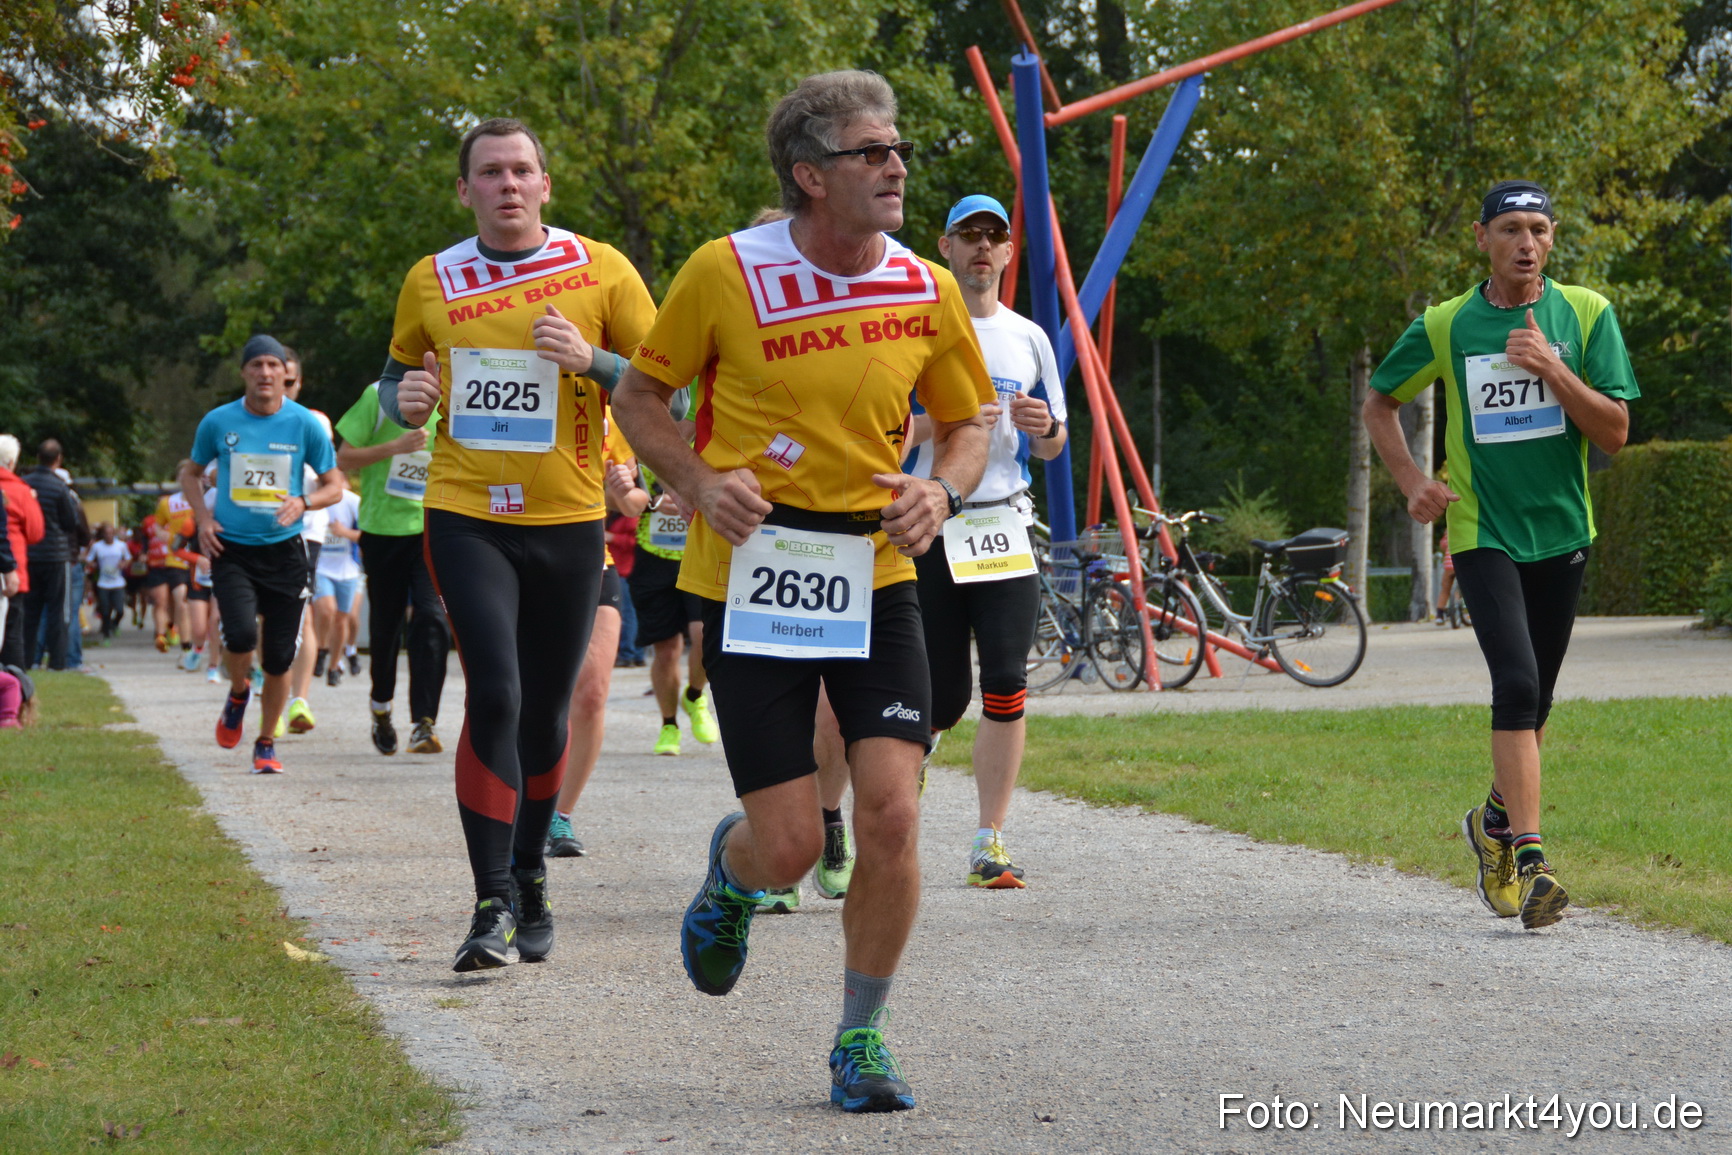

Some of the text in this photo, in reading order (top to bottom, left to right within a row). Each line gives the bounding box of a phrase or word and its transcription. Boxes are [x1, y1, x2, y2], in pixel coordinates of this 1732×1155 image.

[448, 272, 599, 326] MAX BÖGL
[762, 313, 939, 362] MAX BÖGL
[490, 358, 528, 368] BOCK
[466, 379, 540, 412] 2625
[1481, 376, 1545, 409] 2571
[491, 421, 509, 433] Jiri
[1504, 414, 1533, 426] Albert
[244, 470, 275, 486] 273
[657, 518, 688, 532] 265
[789, 541, 835, 557] BOCK
[965, 532, 1010, 557] 149
[976, 561, 1009, 571] Markus
[748, 566, 851, 614] 2630
[771, 621, 824, 639] Herbert
